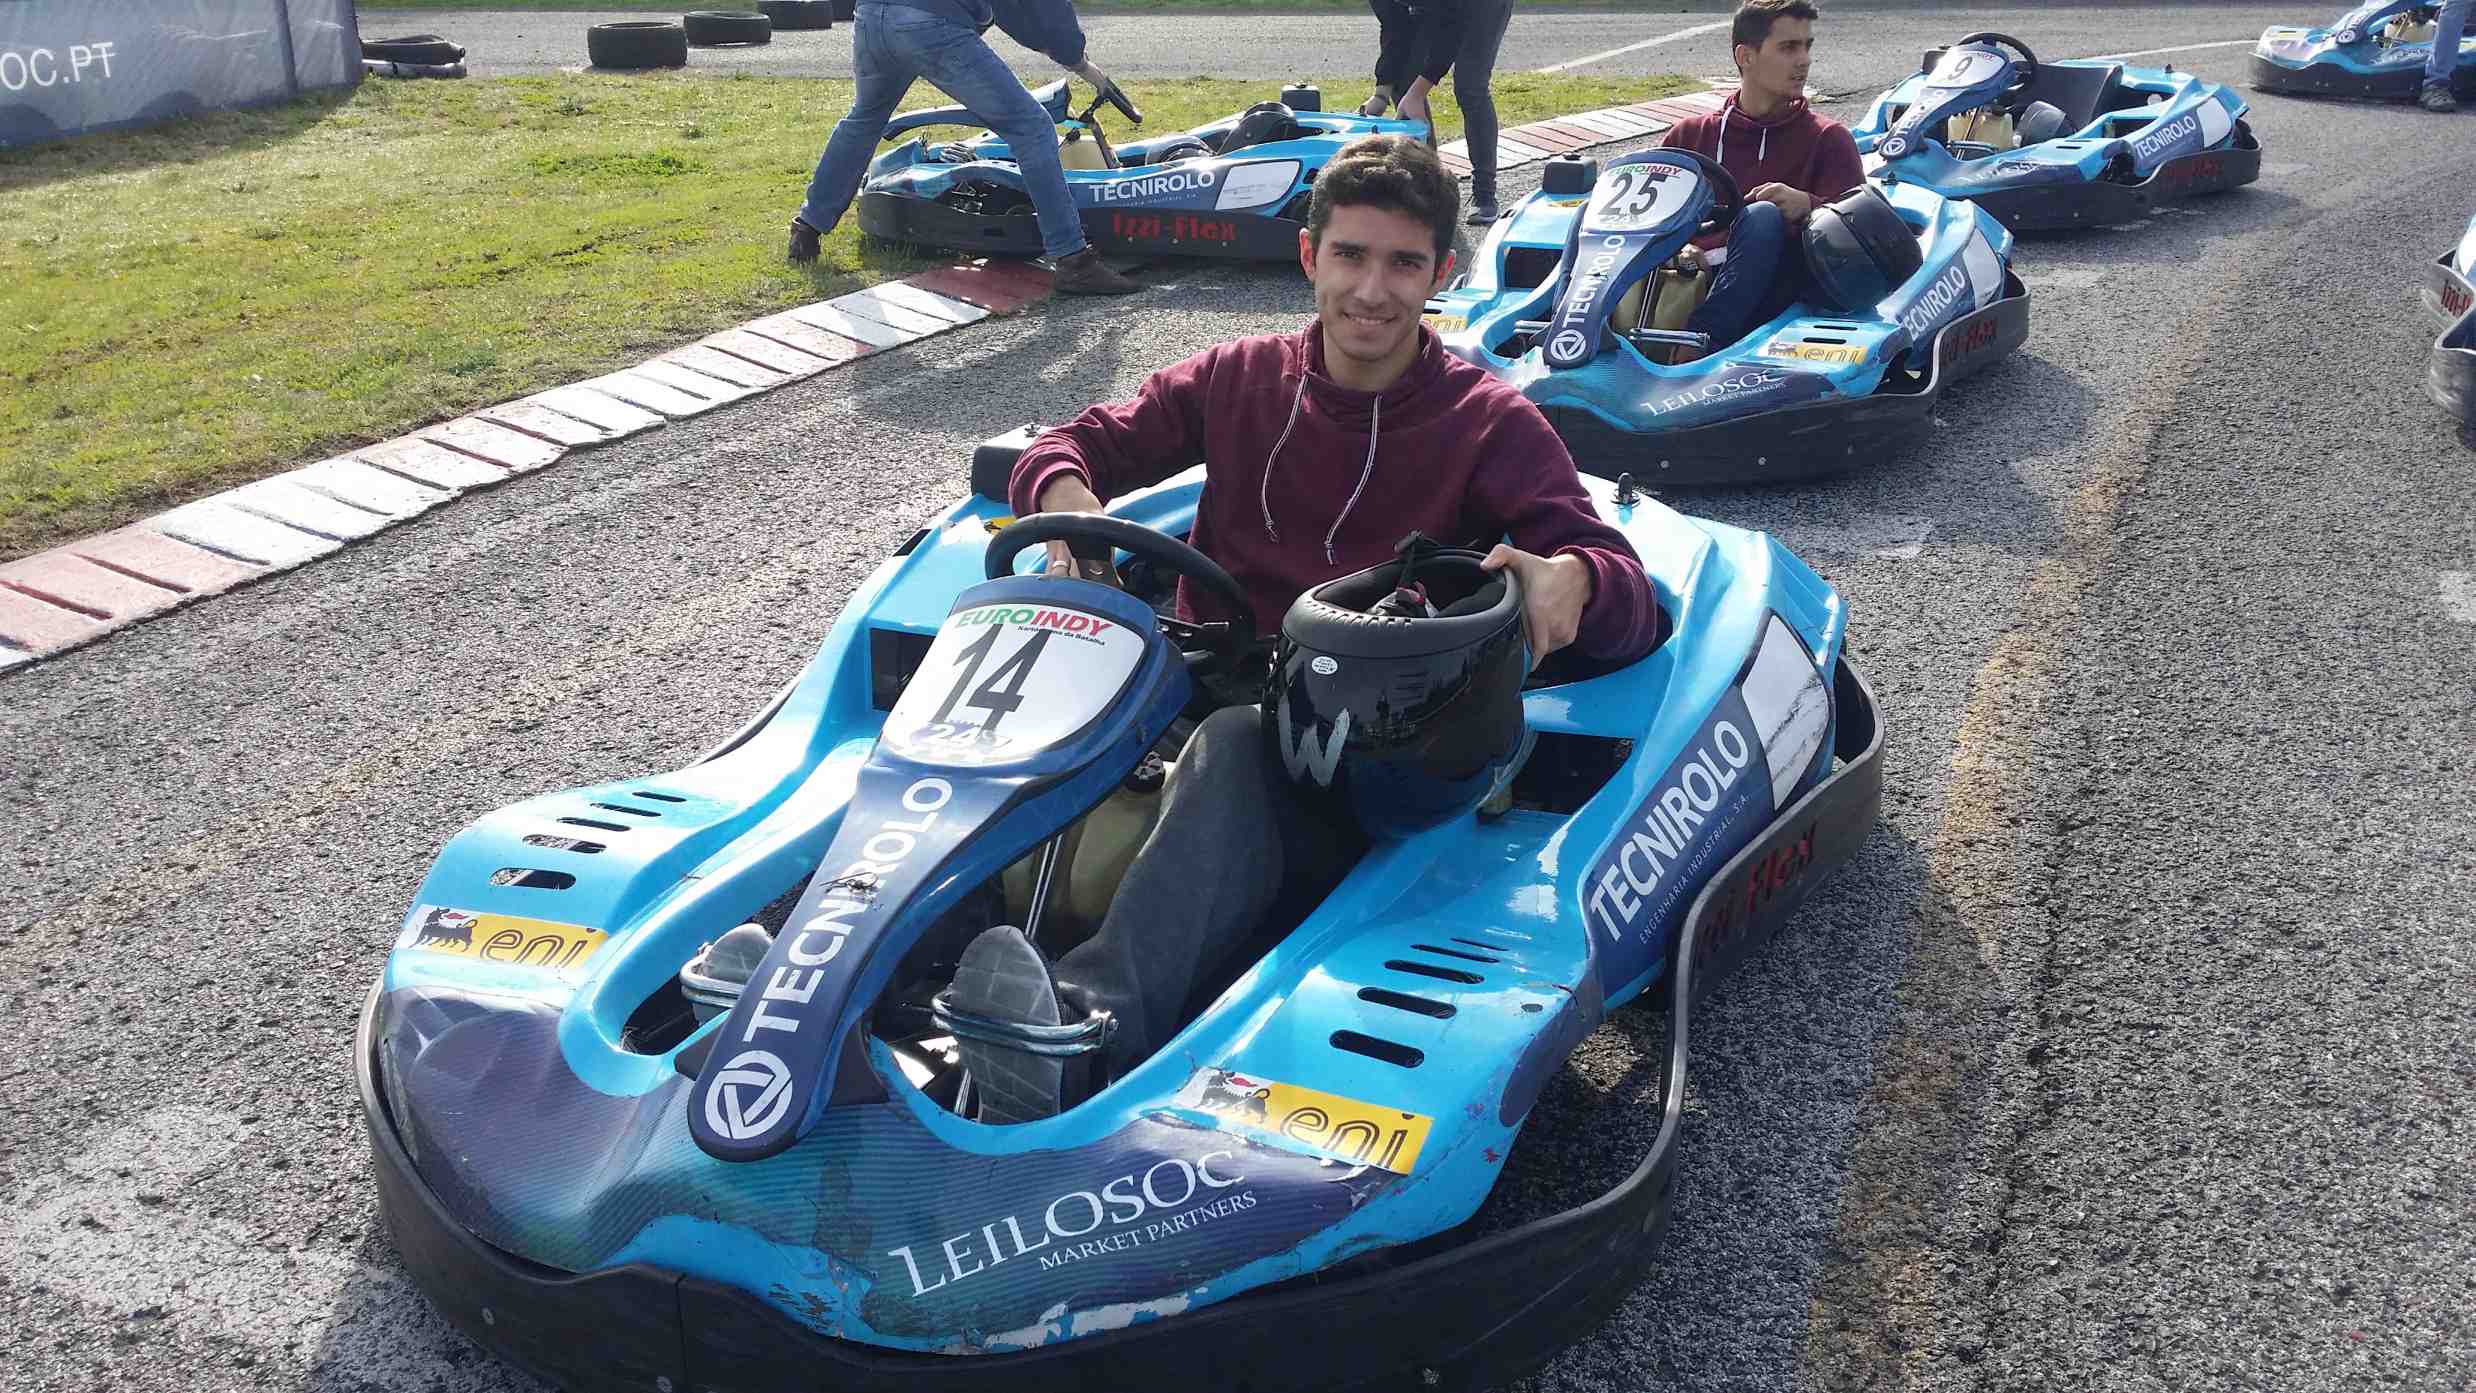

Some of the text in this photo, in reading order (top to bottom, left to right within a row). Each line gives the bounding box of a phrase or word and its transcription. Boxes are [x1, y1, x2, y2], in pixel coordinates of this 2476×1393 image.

[1949, 56, 1973, 80] 9
[2135, 115, 2197, 160] TECNIROLO
[1088, 170, 1216, 202] TECNIROLO
[1597, 172, 1668, 216] 25
[955, 608, 1111, 636] EUROINDY
[930, 623, 1053, 733] 14
[1591, 720, 1750, 942] TECNIROLO
[1639, 873, 1691, 945] ENGENHARIA
[480, 927, 596, 968] eni
[1281, 1106, 1416, 1169] eni
[888, 1150, 1246, 1298] LEILOSOC
[1039, 1190, 1257, 1272] MARKET PARTNERS
